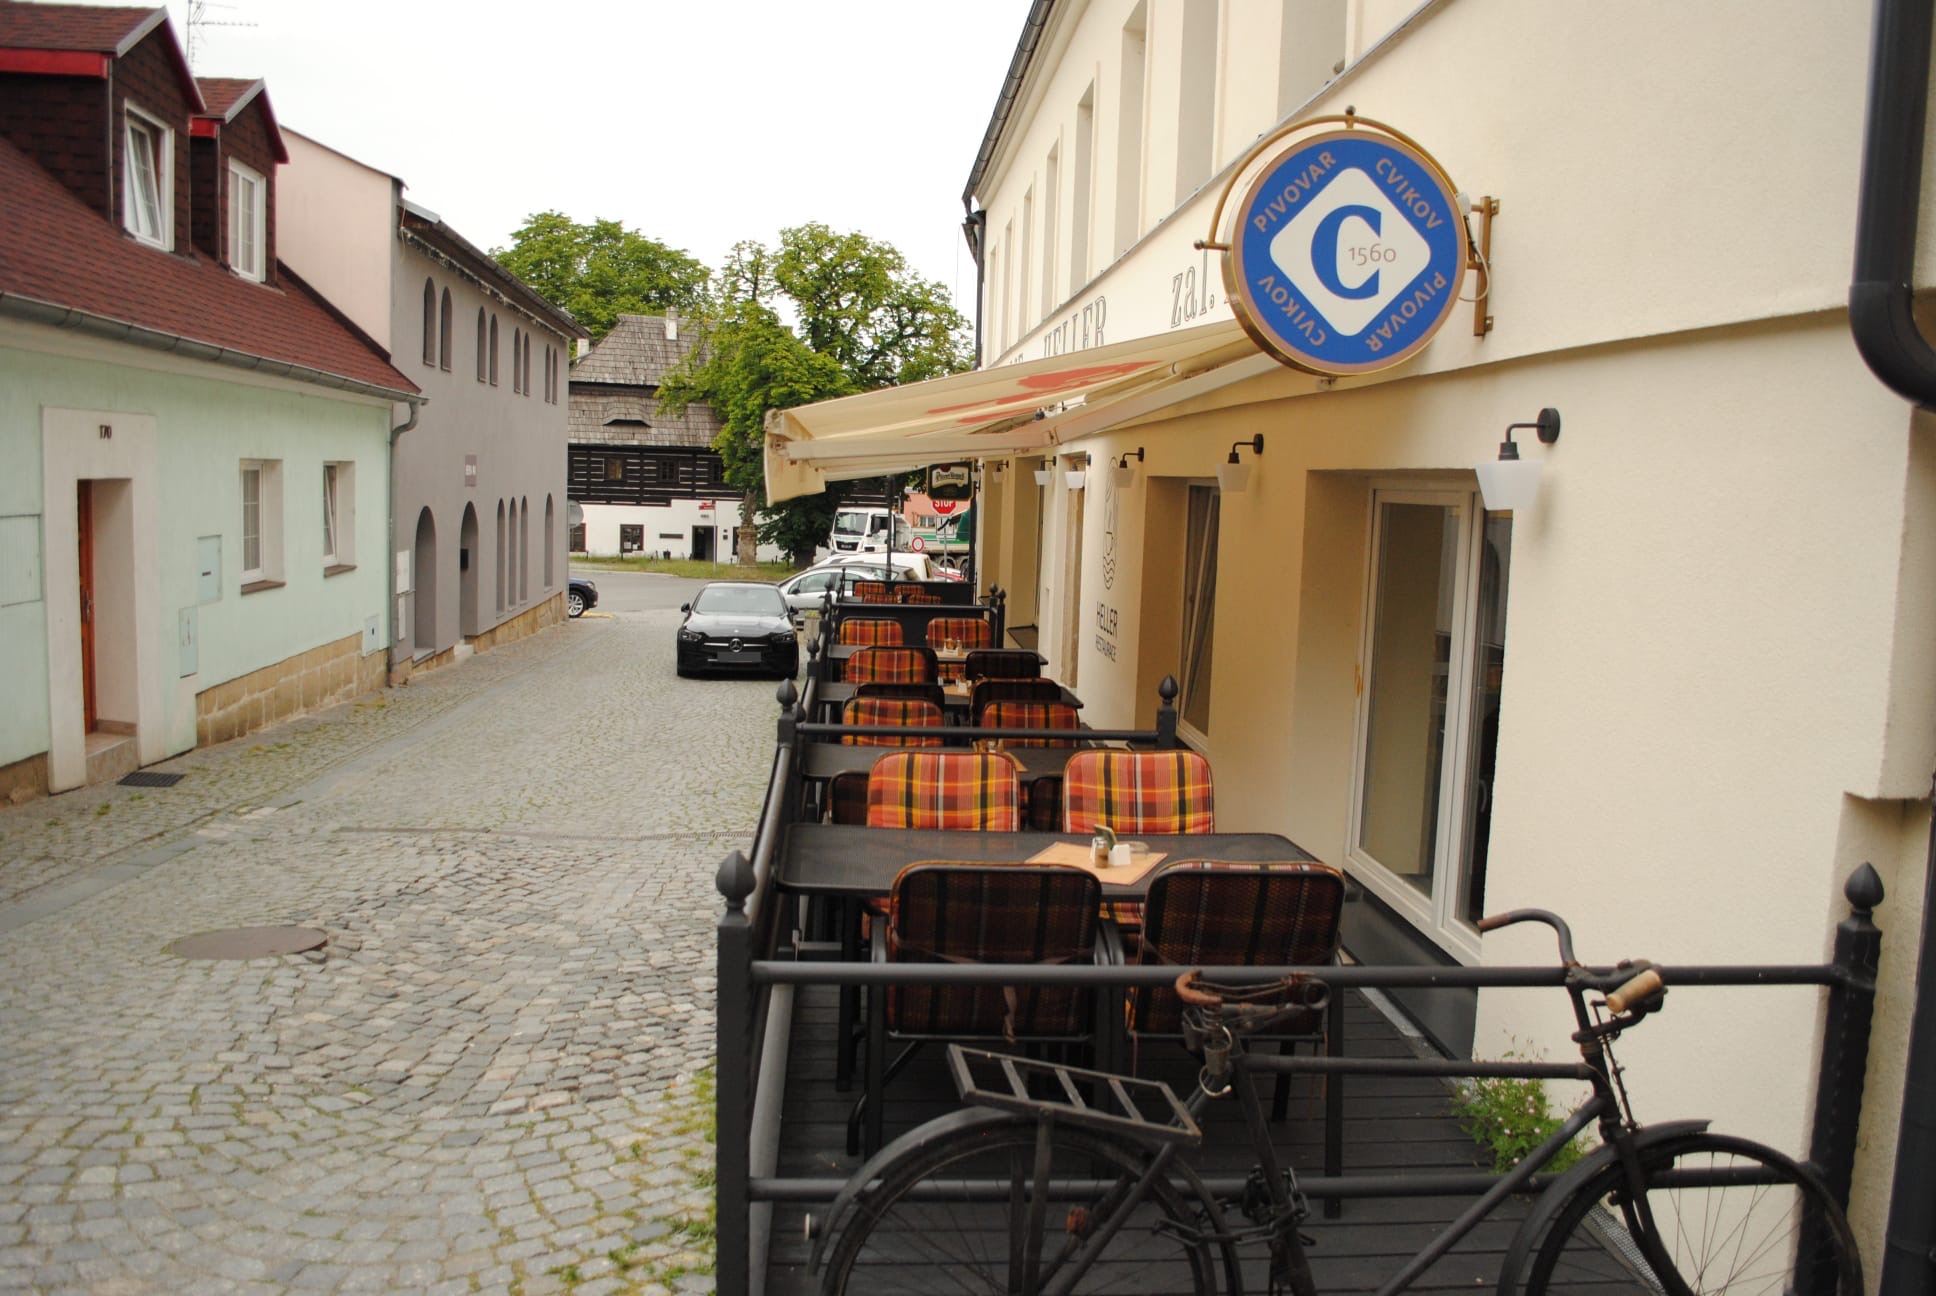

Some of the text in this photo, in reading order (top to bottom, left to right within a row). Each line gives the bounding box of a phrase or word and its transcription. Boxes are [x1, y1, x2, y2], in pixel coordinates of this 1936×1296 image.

[1254, 151, 1444, 232] PIVOVAR CVIKOV
[1310, 204, 1382, 300] C
[1348, 243, 1396, 266] 1560
[1257, 272, 1447, 352] PIVOVAR CVIKOV
[99, 424, 112, 440] 170
[1096, 600, 1118, 640] HELLER
